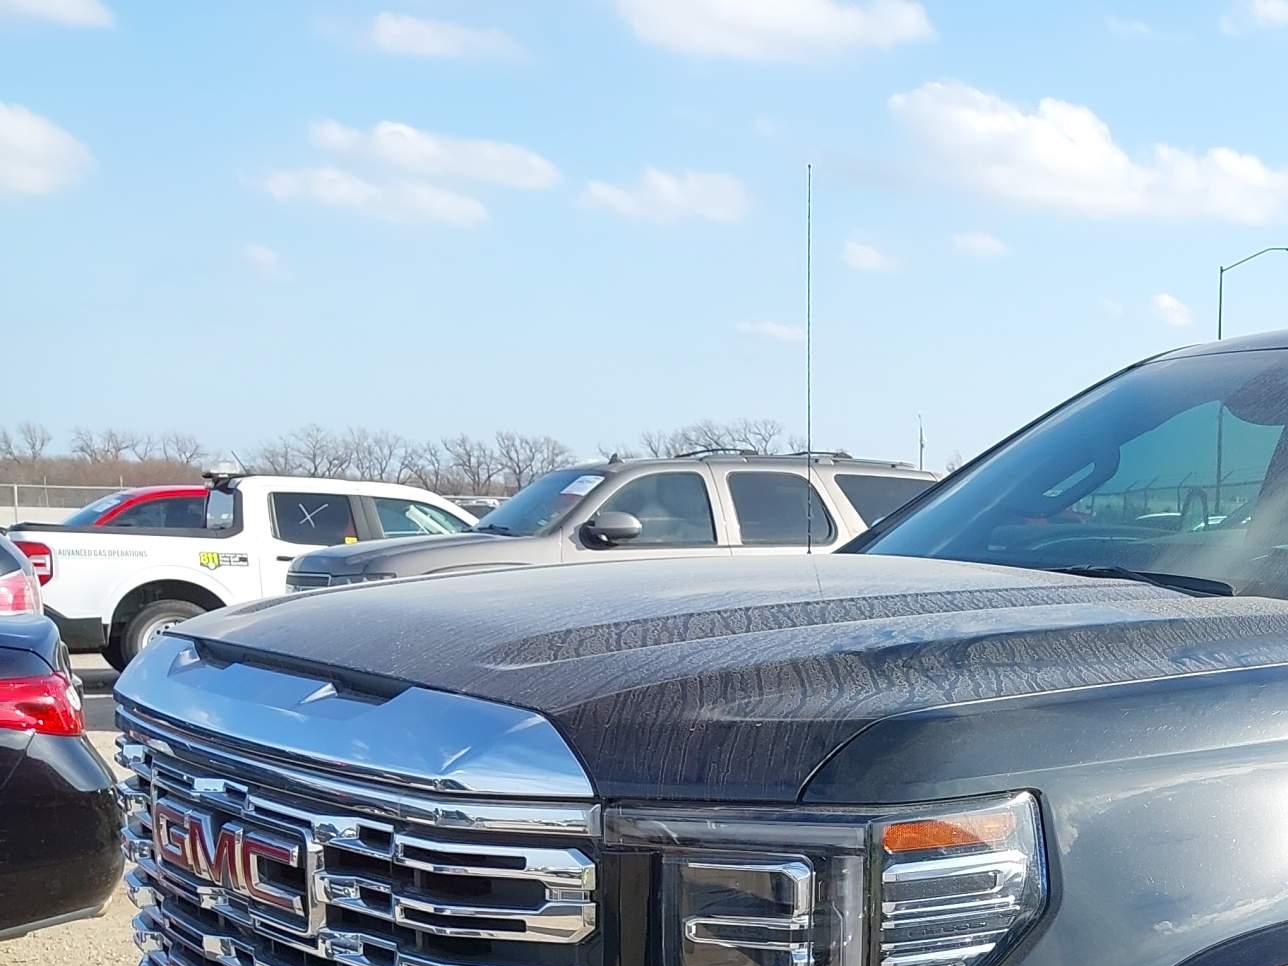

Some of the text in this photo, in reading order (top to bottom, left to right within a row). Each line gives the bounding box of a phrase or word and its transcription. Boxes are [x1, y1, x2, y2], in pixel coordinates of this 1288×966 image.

[58, 548, 148, 558] ADVANCED GAS OPERATIONS
[155, 799, 305, 918] GMC
